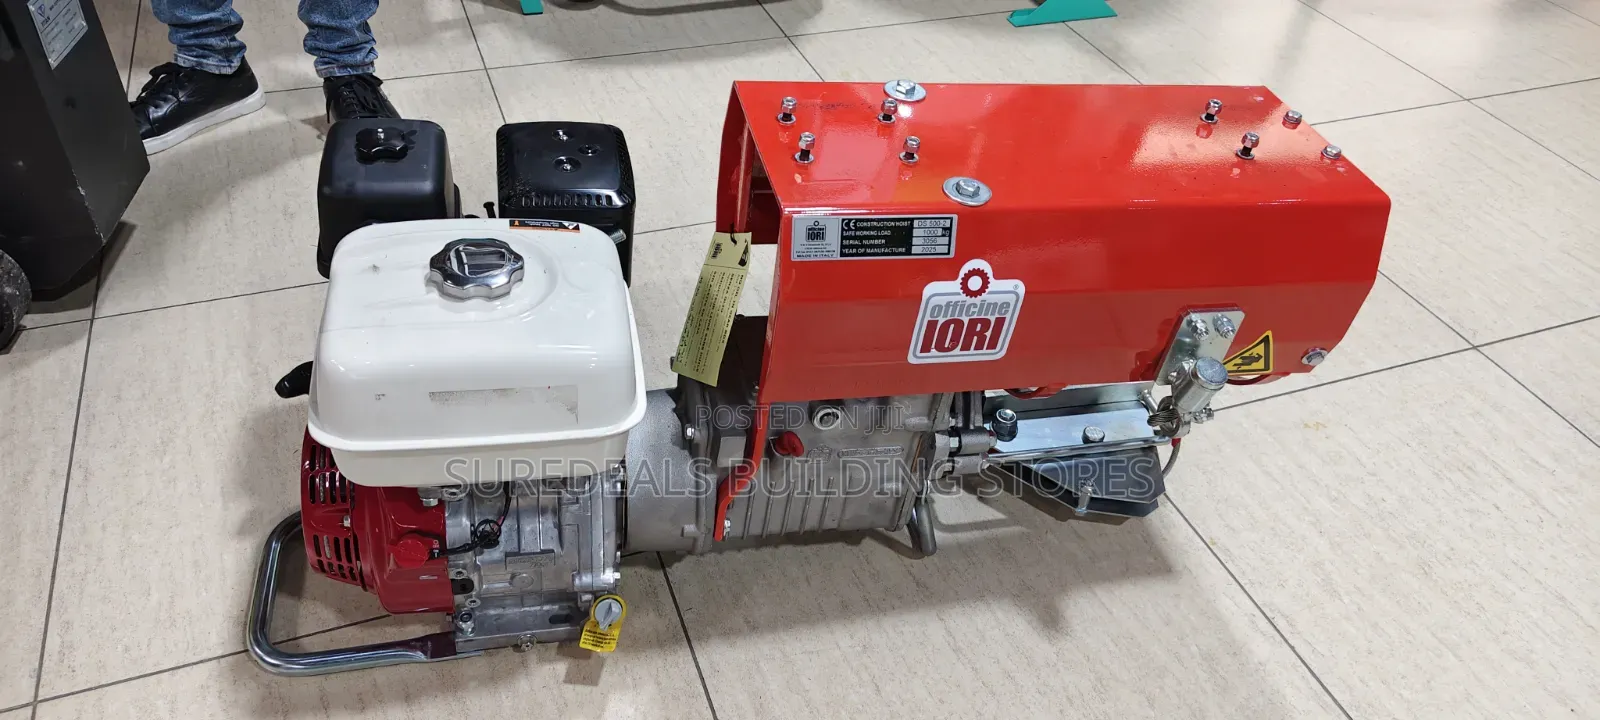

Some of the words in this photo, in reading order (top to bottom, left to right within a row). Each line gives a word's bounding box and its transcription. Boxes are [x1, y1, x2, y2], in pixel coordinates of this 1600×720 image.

[807, 231, 825, 241] IORI
[942, 228, 950, 236] kg
[929, 299, 1011, 319] officine
[919, 316, 1007, 354] IORI
